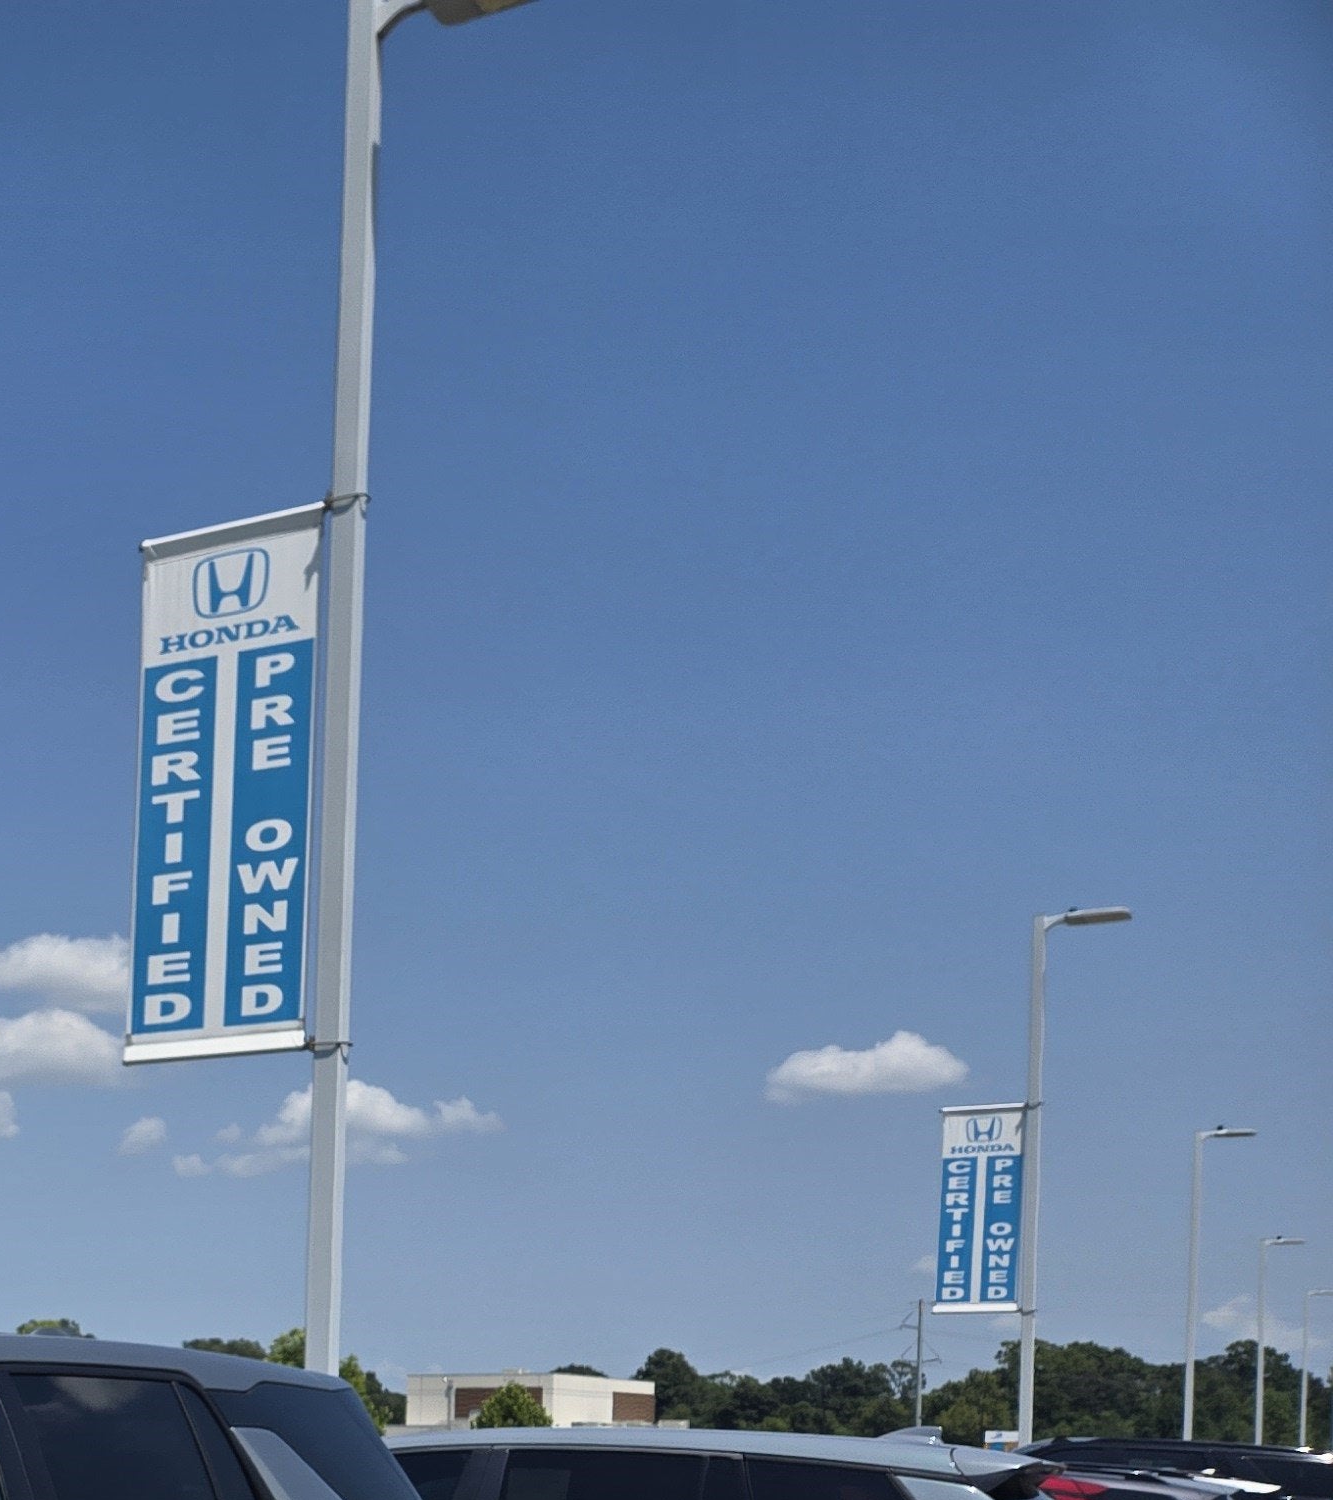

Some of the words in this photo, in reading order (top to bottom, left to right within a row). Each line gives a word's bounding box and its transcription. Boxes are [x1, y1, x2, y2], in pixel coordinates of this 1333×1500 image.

[159, 614, 300, 656] HONDA
[250, 651, 296, 772] PRE
[143, 667, 206, 1027] CERTIFIED
[237, 818, 299, 1018] OWNED
[949, 1143, 1015, 1155] HONDA
[992, 1158, 1013, 1205] PRE
[941, 1160, 973, 1301] CERTIFIED
[986, 1222, 1015, 1300] OWNED
